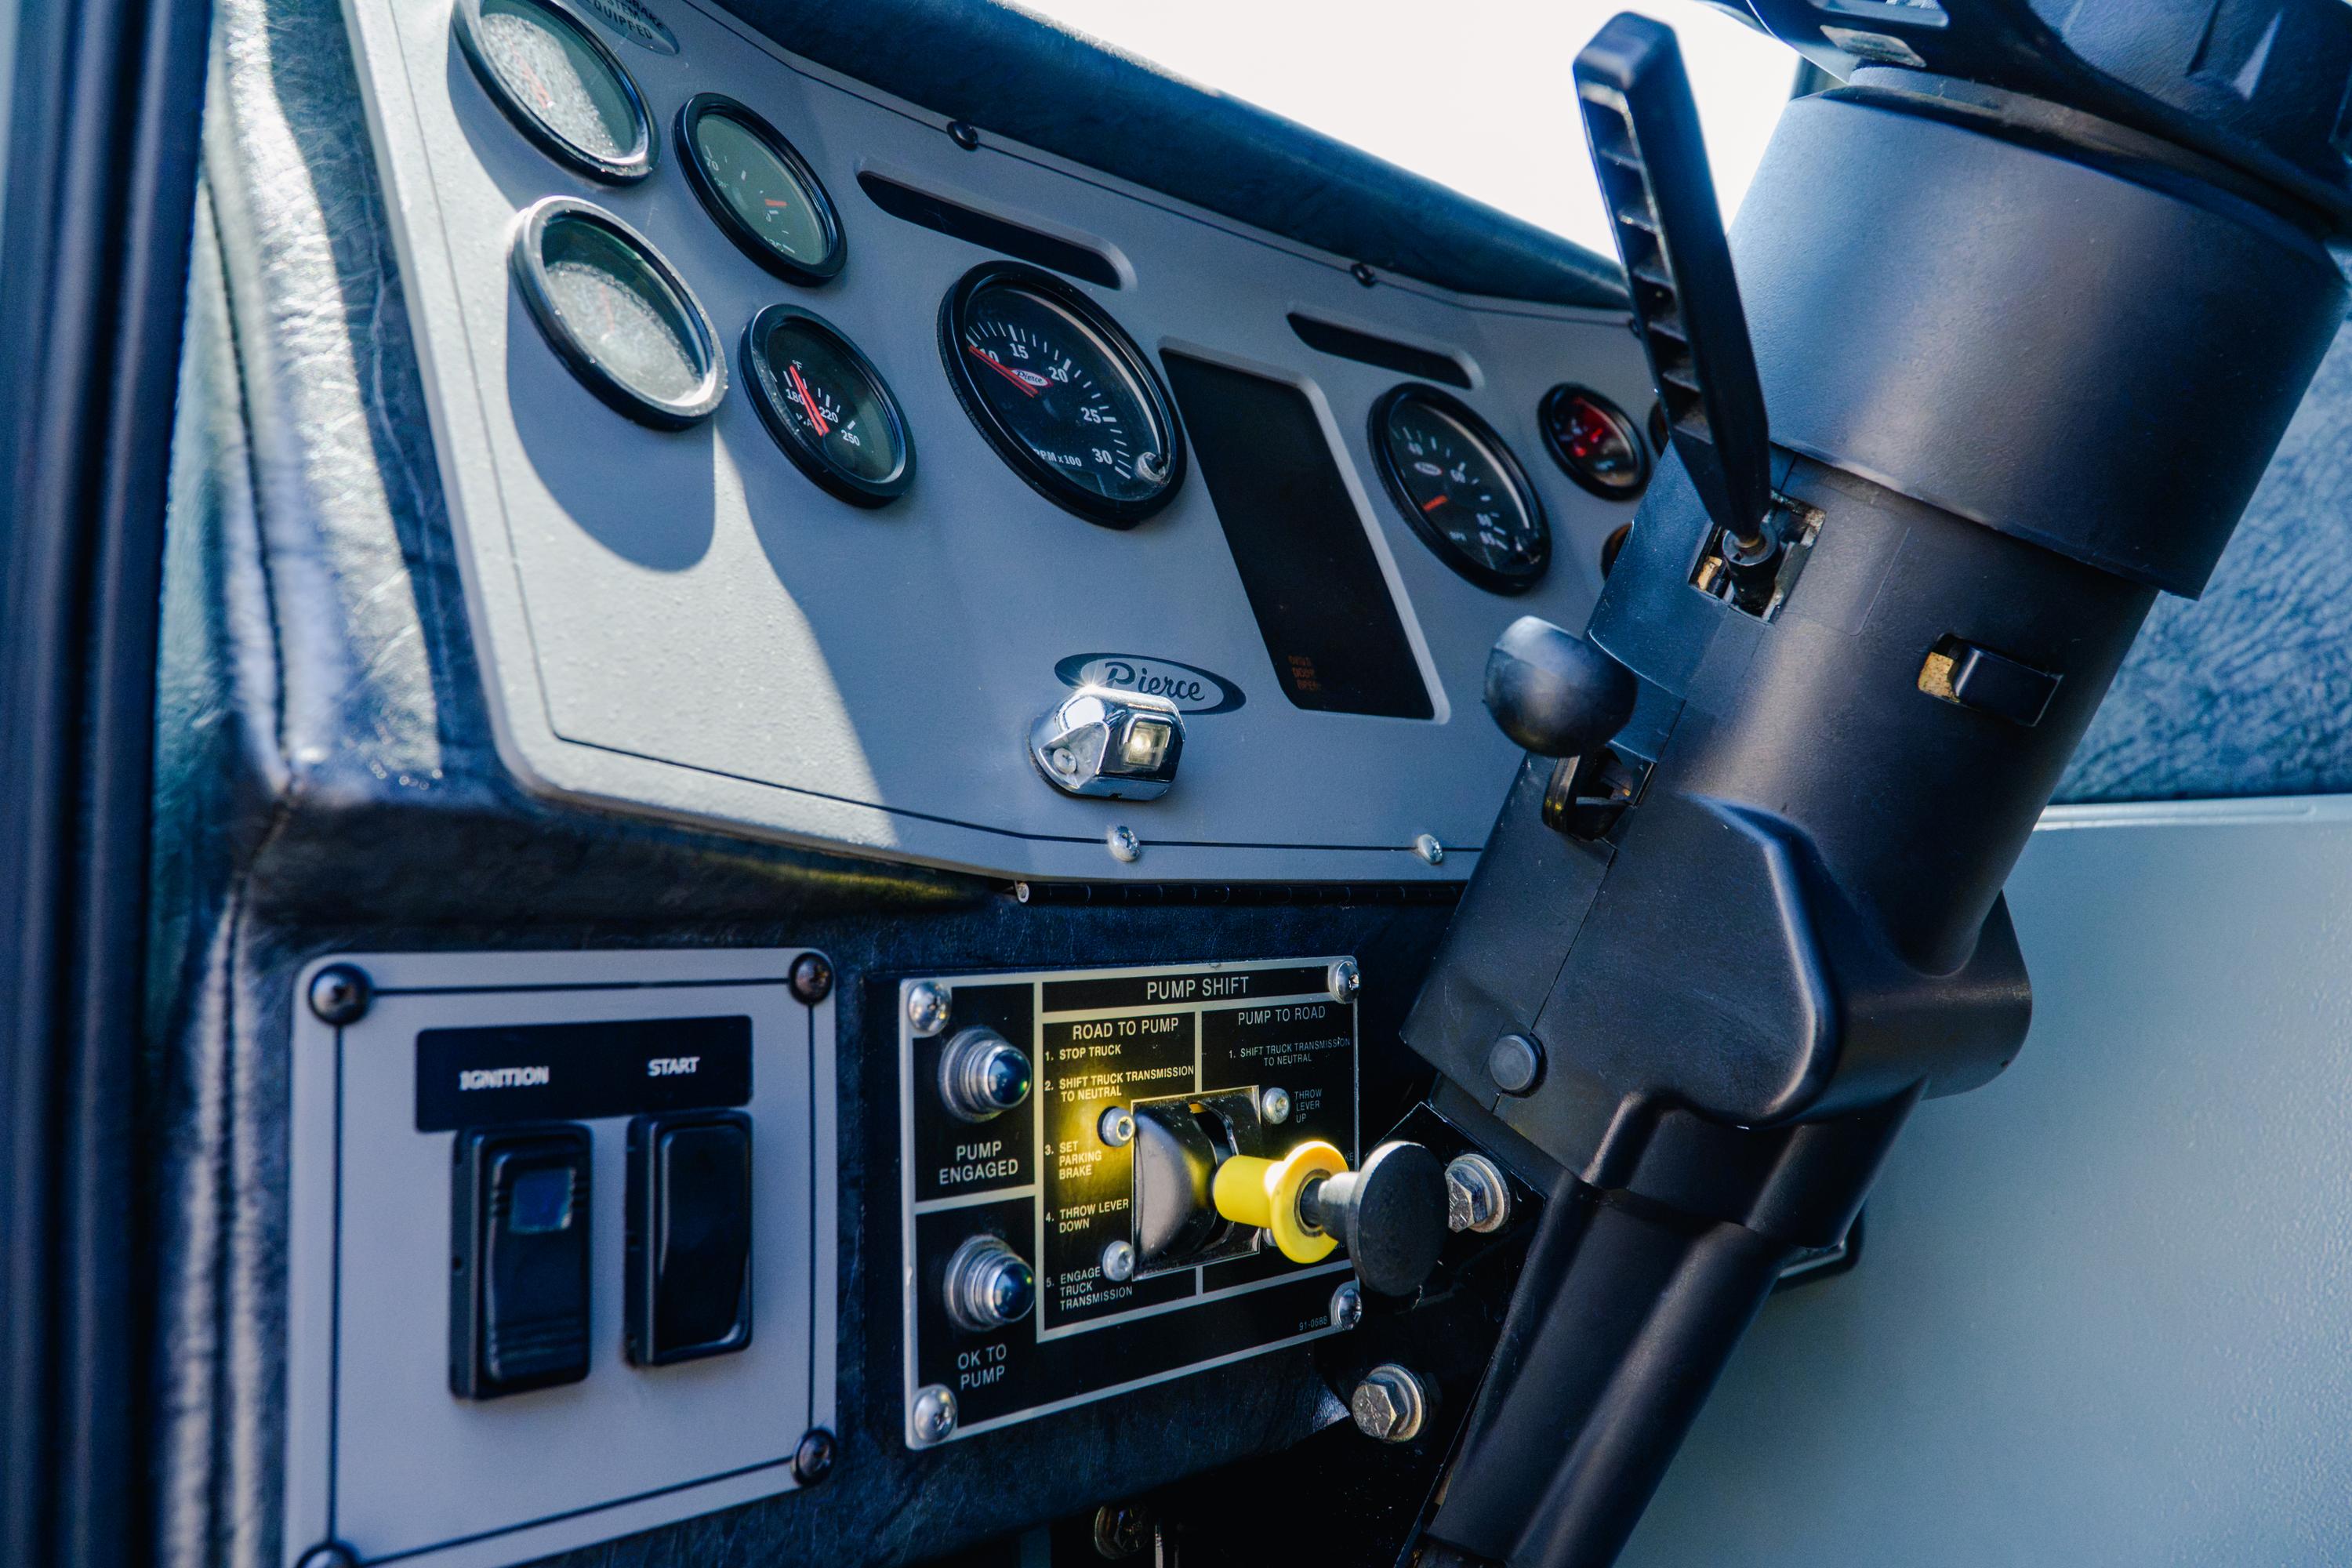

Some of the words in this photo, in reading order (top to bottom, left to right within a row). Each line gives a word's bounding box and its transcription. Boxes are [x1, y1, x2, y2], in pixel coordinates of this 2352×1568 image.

[586, 0, 652, 39] QUIPPED
[1010, 343, 1029, 359] 15
[1048, 366, 1069, 383] 20
[818, 405, 838, 423] 220
[1080, 407, 1101, 423] 25
[840, 429, 860, 446] 250
[1091, 448, 1112, 465] 30
[1105, 661, 1205, 701] Pierce
[1147, 979, 1196, 1000] PUMP
[1202, 976, 1249, 997] SHIFT
[1238, 1010, 1271, 1025] PUMP
[1276, 1008, 1290, 1022] TO
[1294, 1006, 1326, 1020] ROAD
[1073, 1022, 1113, 1040] ROAD
[1118, 1020, 1136, 1036] TO
[1142, 1017, 1179, 1034] PUMP
[1045, 1051, 1054, 1062] 1.
[1059, 1046, 1087, 1060] STOP
[1089, 1044, 1121, 1057] TRUCK
[1229, 1050, 1236, 1058] 1.
[1240, 1046, 1264, 1058] SHIFT
[1266, 1043, 1292, 1054] TRUCK
[1294, 1036, 1350, 1051] TRANSMISSION
[647, 1056, 700, 1076] START
[1264, 1057, 1275, 1067] TO
[1277, 1053, 1312, 1065] NEUTRAL
[459, 1065, 550, 1091] IGNITION
[1044, 1080, 1054, 1091] 2.
[1059, 1076, 1088, 1090] SHIFT
[1091, 1073, 1123, 1085] TRUCK
[1126, 1065, 1194, 1081] TRANSMISSION
[1061, 1091, 1075, 1102] TO
[1078, 1085, 1122, 1101] NEUTRAL
[1294, 1087, 1323, 1101] THROW
[1296, 1100, 1320, 1112] LEVER
[1296, 1112, 1307, 1123] UP
[956, 1140, 1002, 1162] PUMP
[1044, 1144, 1054, 1156] 3.
[1059, 1141, 1079, 1153] SET
[1059, 1150, 1102, 1167] PARKING
[939, 1158, 1018, 1185] ENGAGED
[1059, 1164, 1092, 1180] BRAKE
[1045, 1212, 1054, 1222] 4.
[1059, 1203, 1096, 1220] THROW
[1098, 1198, 1129, 1213] LEVER
[1059, 1218, 1090, 1233] DOWN
[1046, 1276, 1054, 1287] 5.
[1060, 1266, 1101, 1284] ENGAGE
[1060, 1281, 1093, 1298] TRUCK
[1060, 1286, 1133, 1312] TRANSMISSION
[957, 1349, 981, 1370] OK
[985, 1343, 1007, 1363] TO
[960, 1364, 1005, 1392] PUMP
